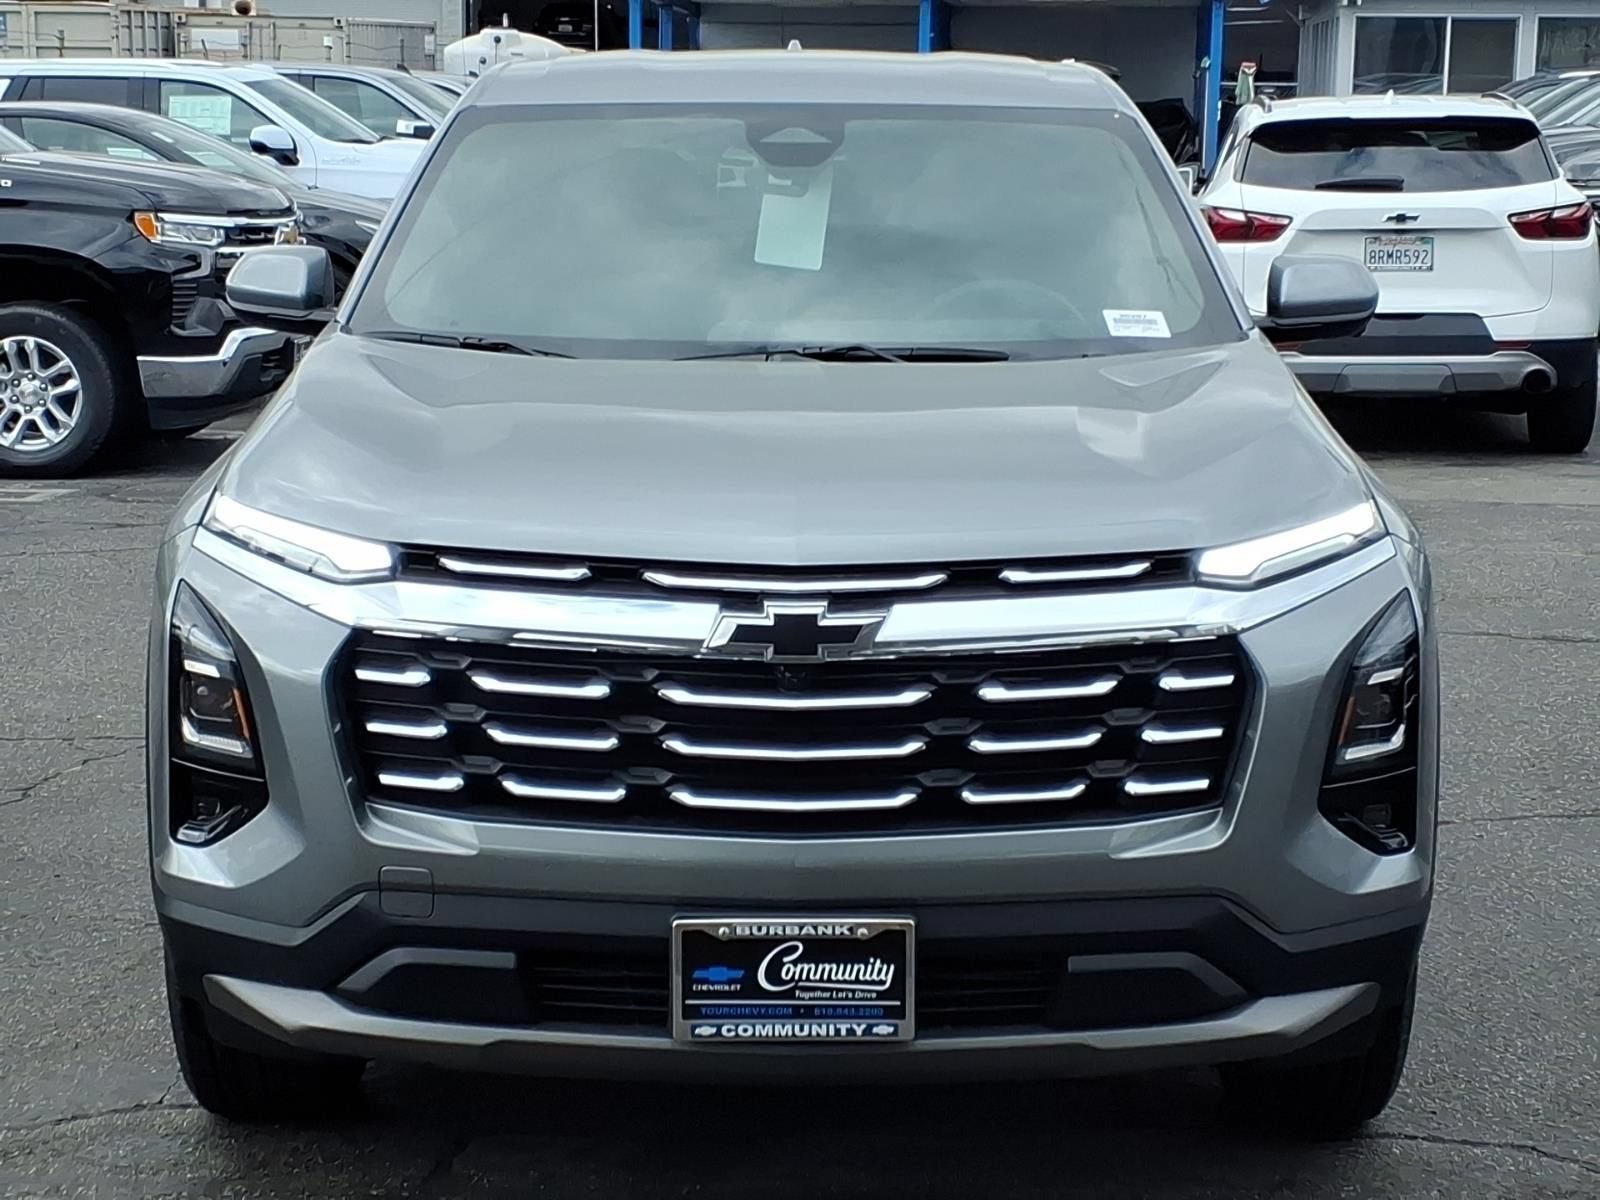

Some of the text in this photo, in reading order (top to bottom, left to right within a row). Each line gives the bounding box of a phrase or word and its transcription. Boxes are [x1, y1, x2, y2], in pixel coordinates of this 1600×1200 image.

[1369, 249, 1429, 264] 8RMR592
[735, 924, 851, 936] BURBANK
[757, 941, 895, 991] Community
[692, 983, 741, 991] CHEVROLET
[795, 990, 831, 999] Together
[855, 990, 877, 999] Drive
[721, 1024, 867, 1037] COMMUNITY
